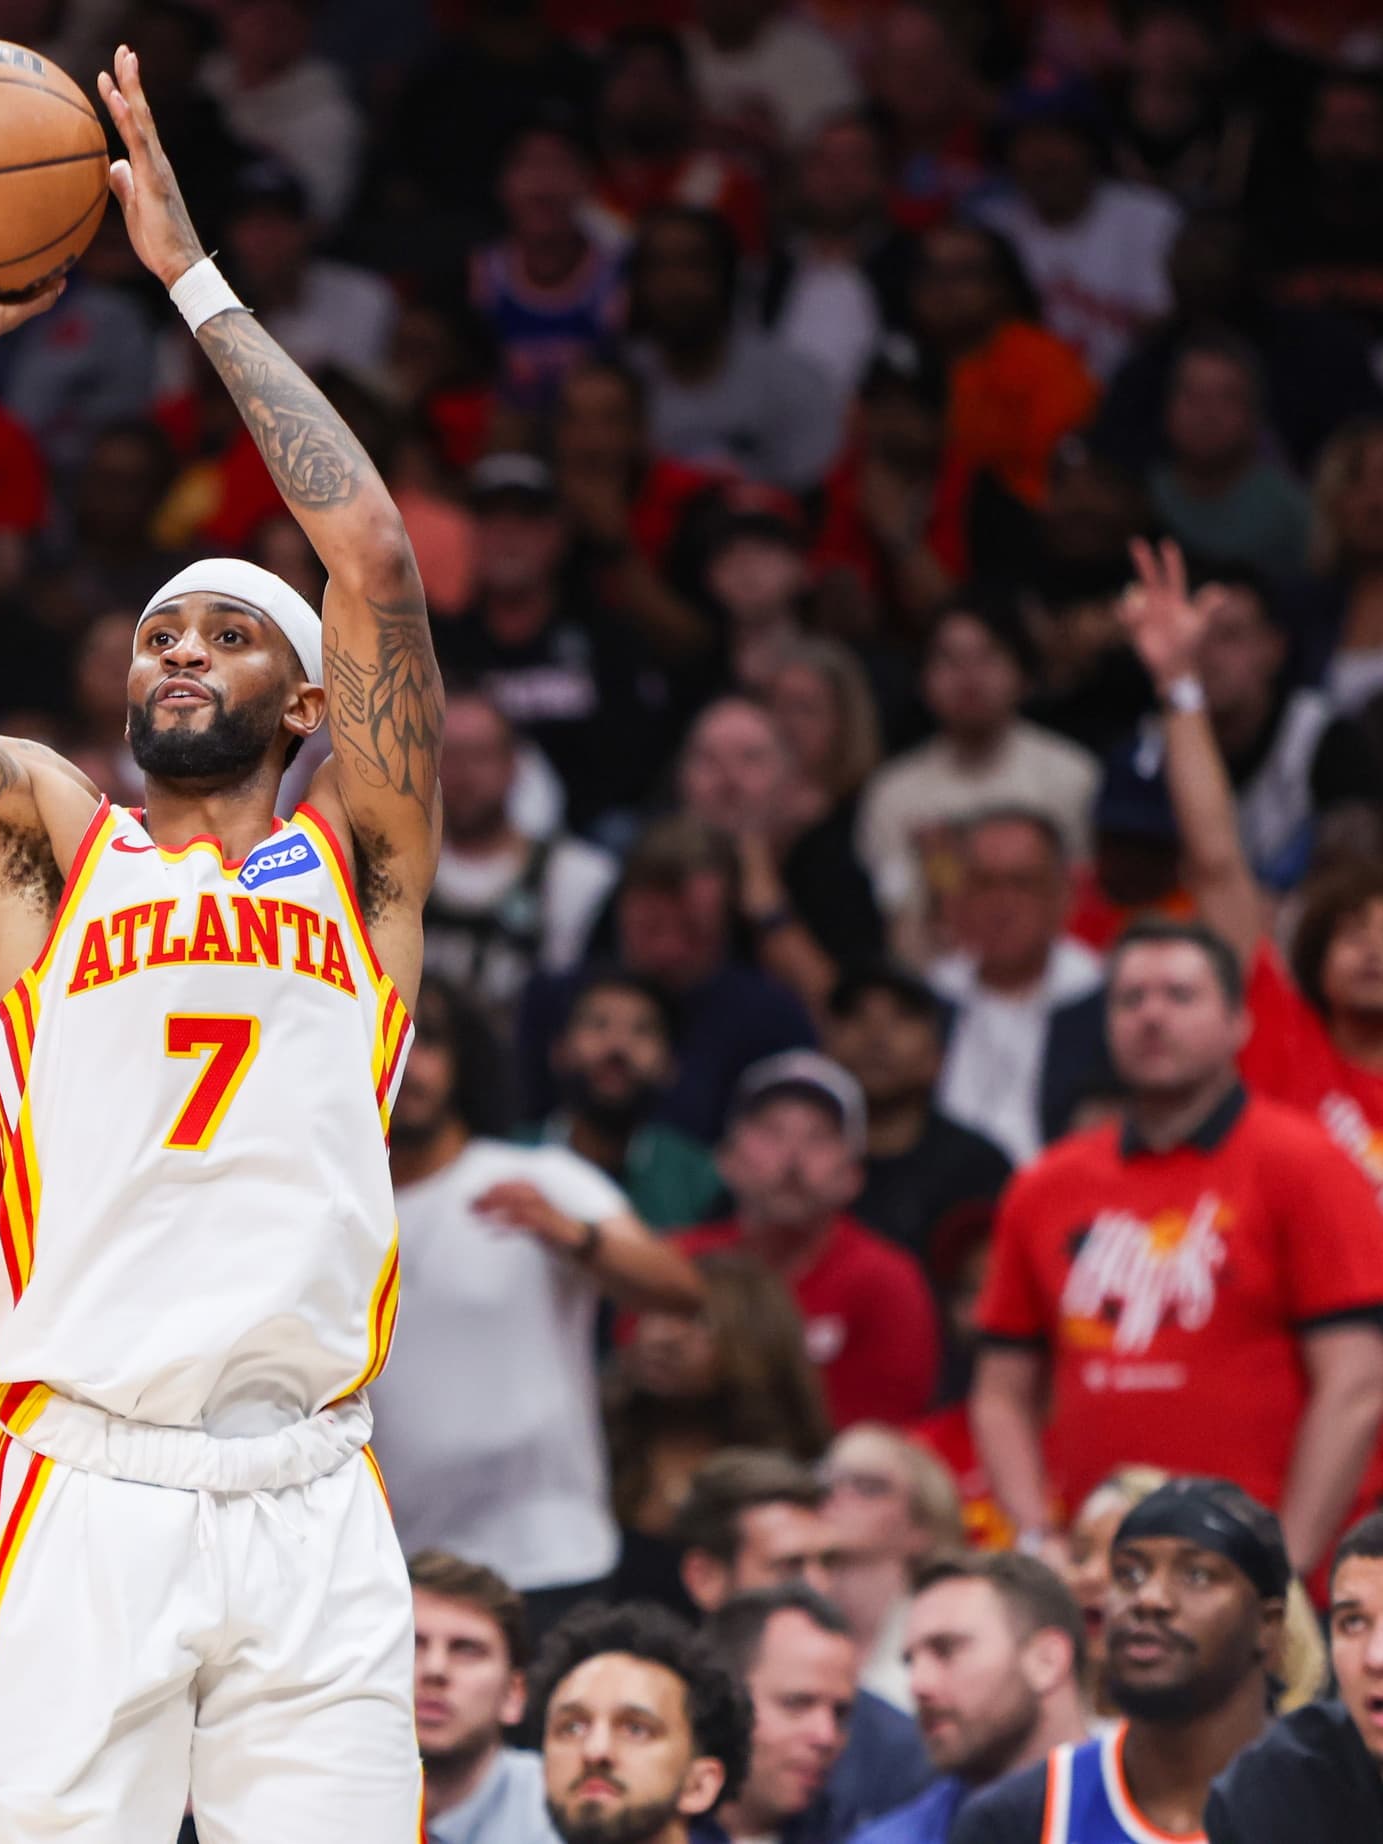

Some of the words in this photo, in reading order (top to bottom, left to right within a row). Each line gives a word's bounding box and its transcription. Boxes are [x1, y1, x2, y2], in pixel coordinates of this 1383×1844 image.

[240, 844, 309, 884] paze
[65, 892, 358, 1000] ATLANTA
[162, 1013, 261, 1151] 7
